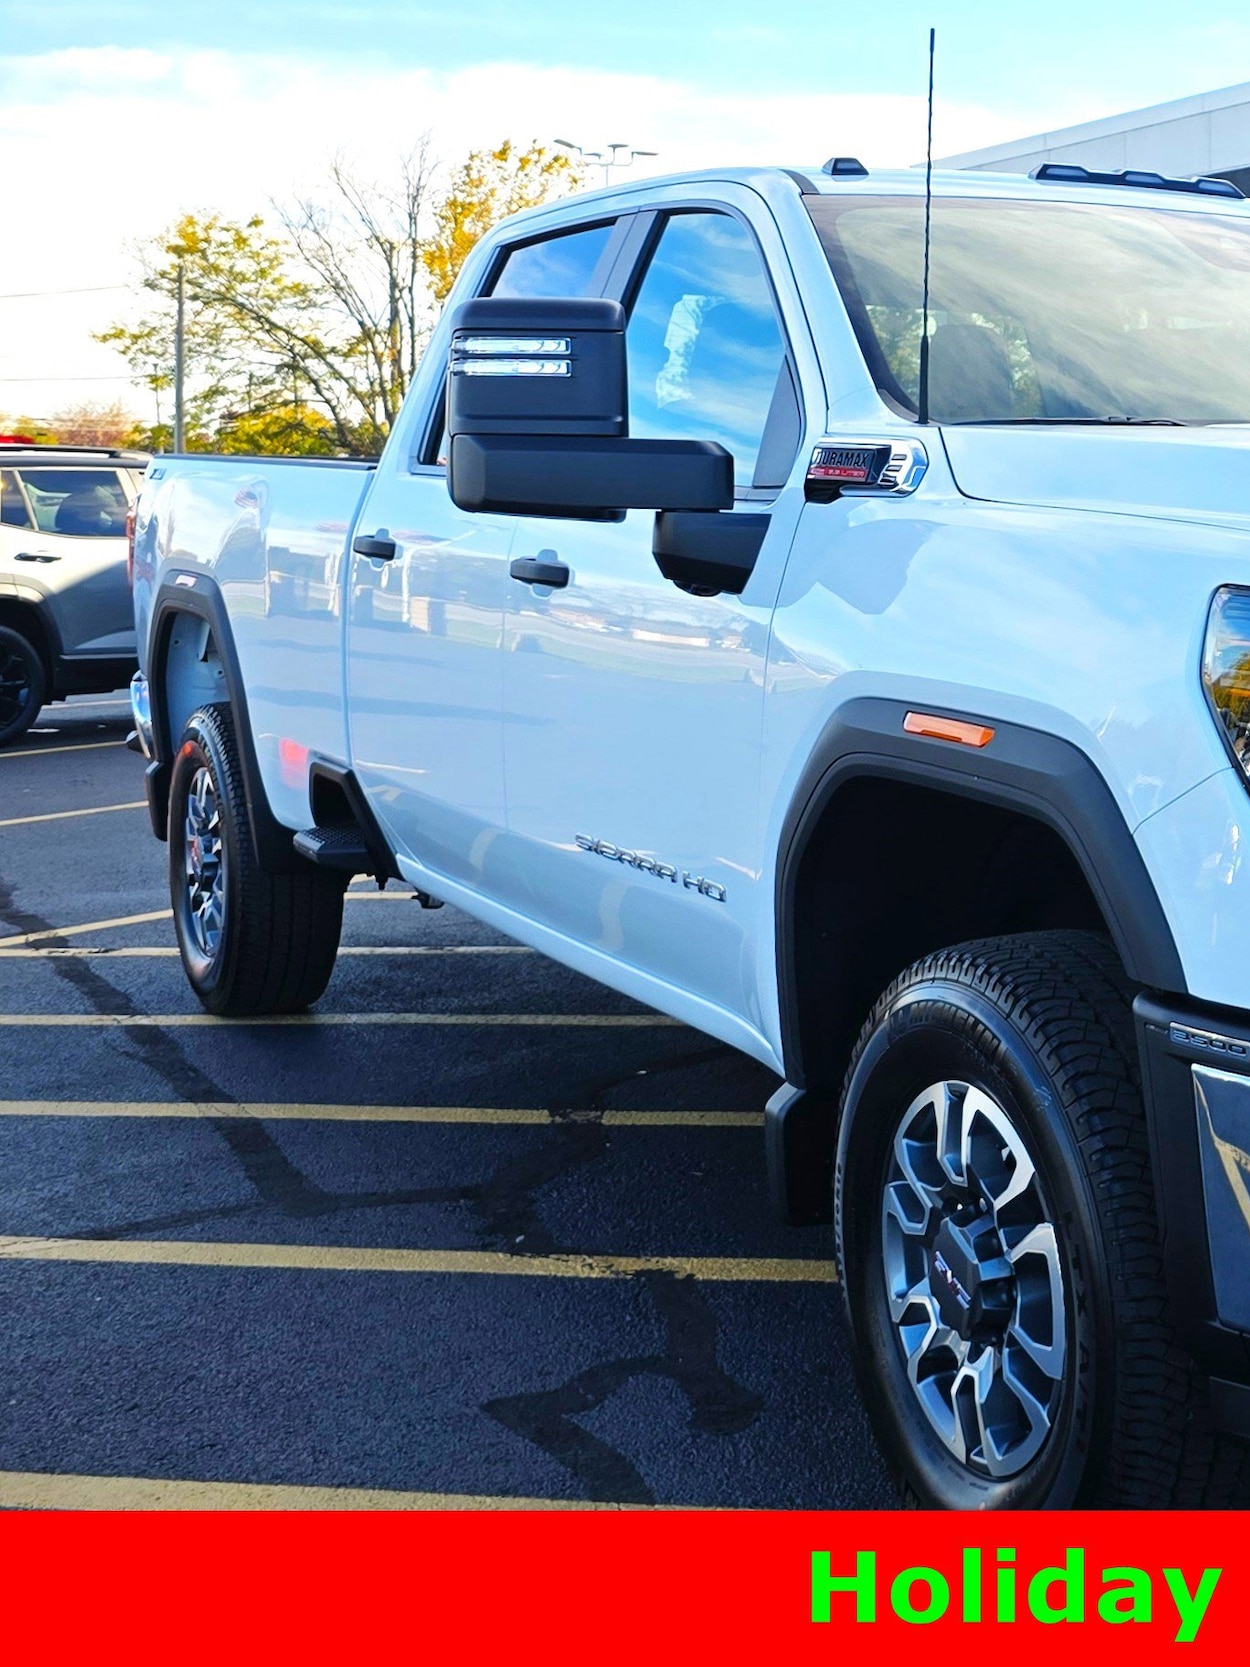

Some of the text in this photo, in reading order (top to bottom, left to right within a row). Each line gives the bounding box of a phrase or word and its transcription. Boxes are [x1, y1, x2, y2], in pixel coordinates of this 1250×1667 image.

[575, 832, 727, 903] SIERRA HD
[1171, 1029, 1248, 1058] 2500
